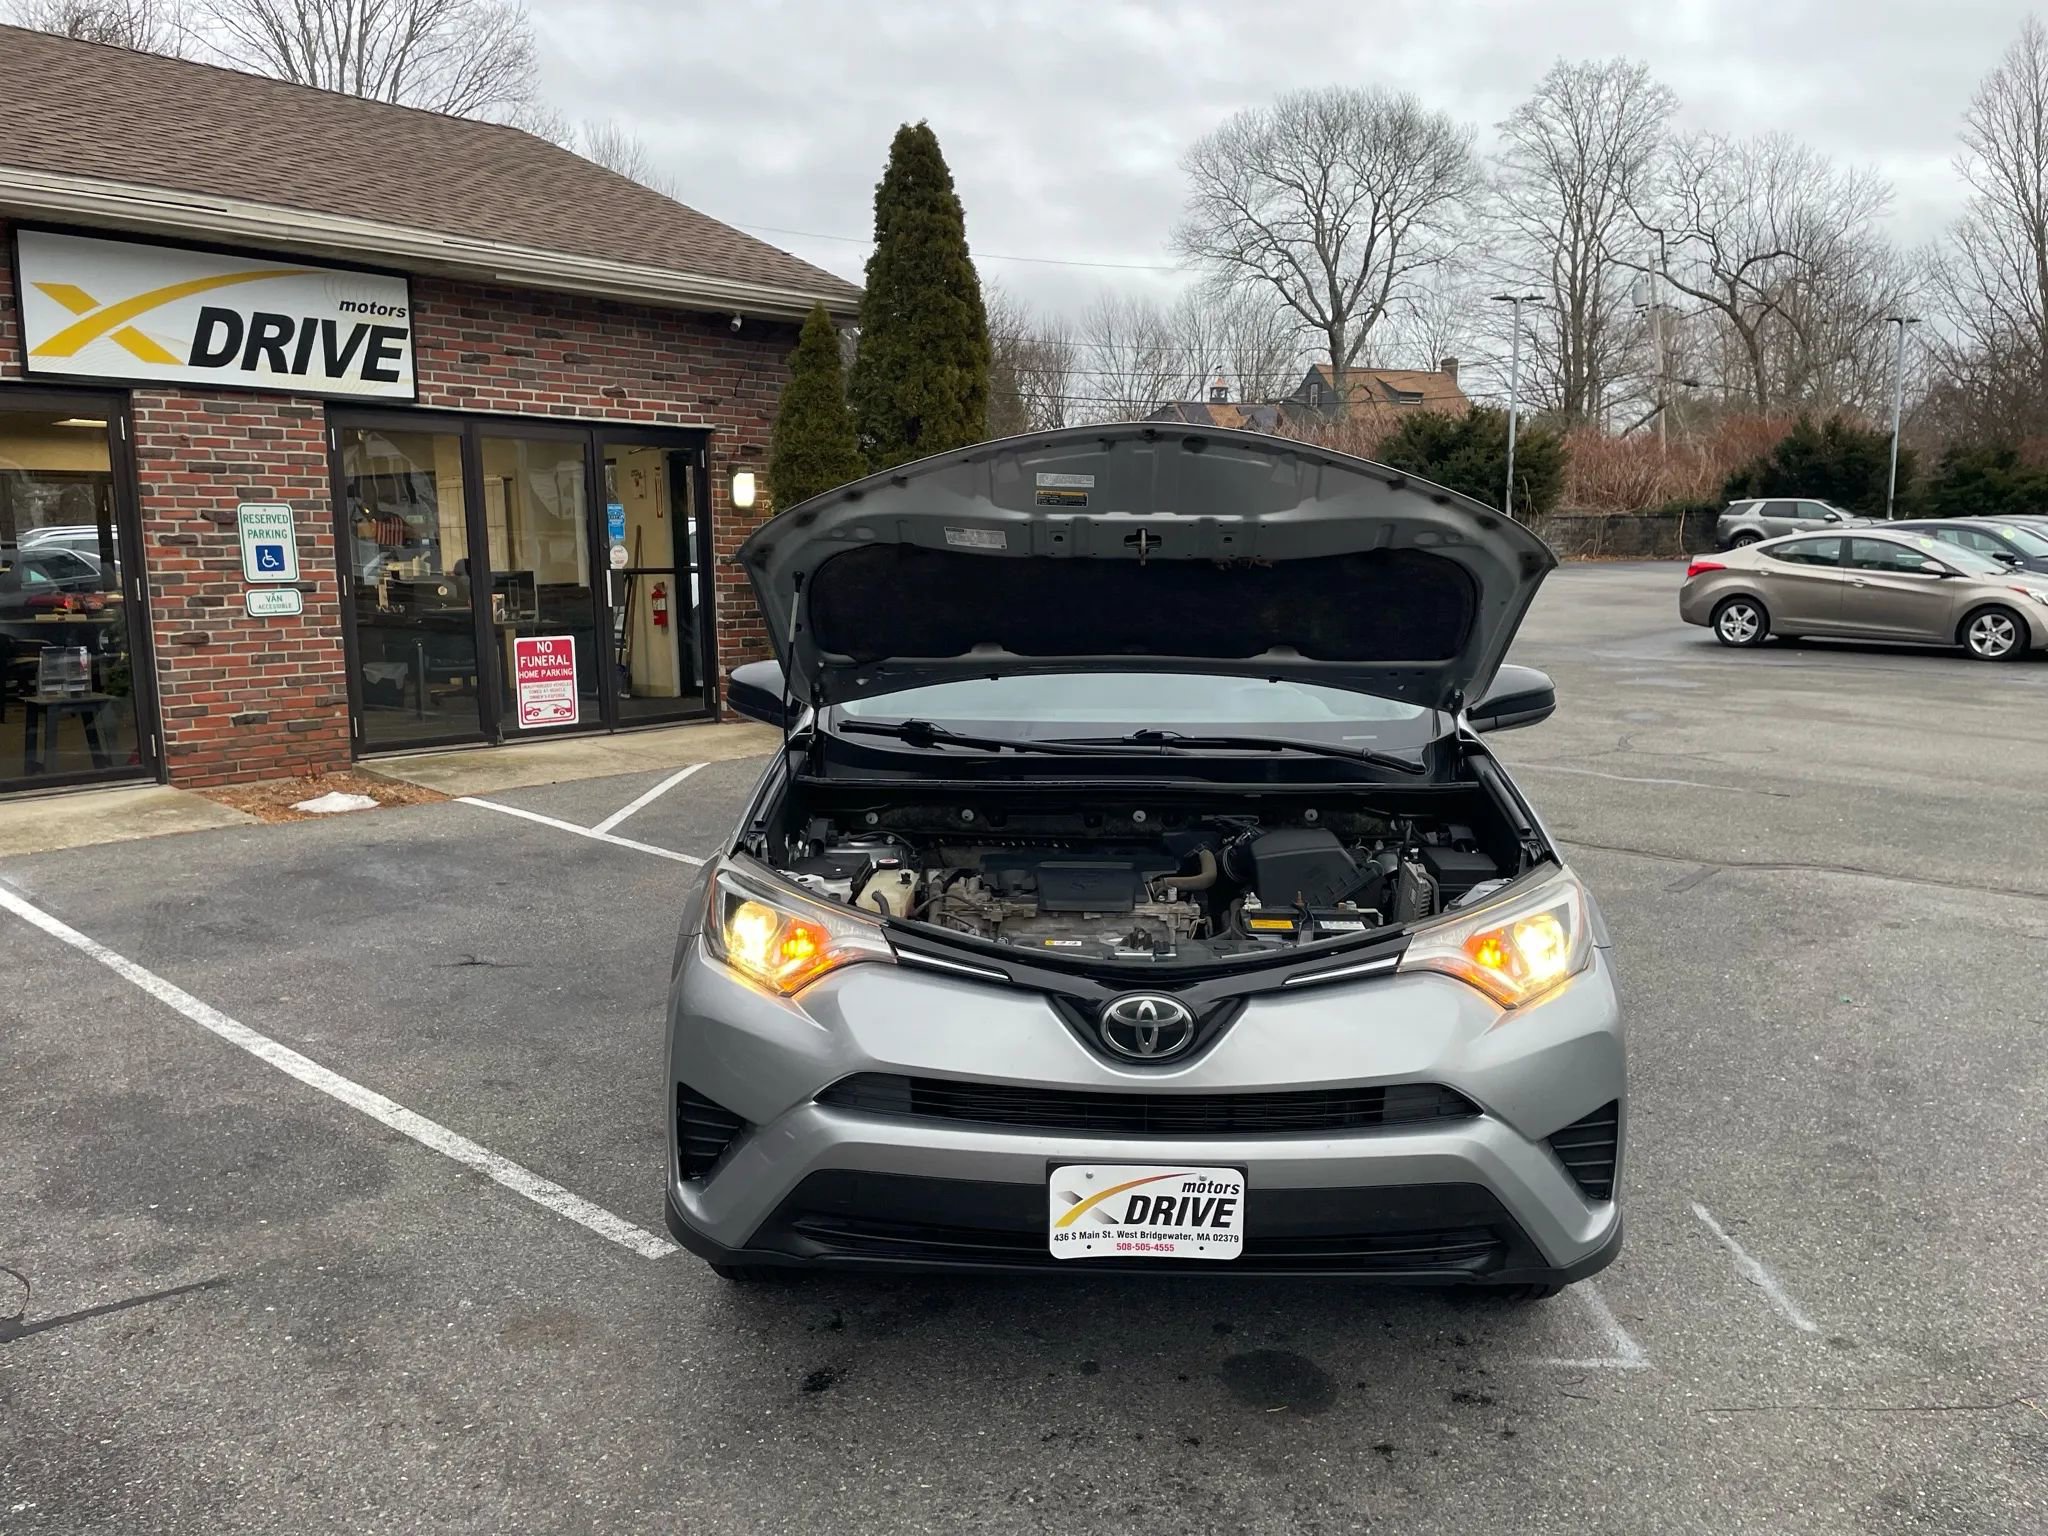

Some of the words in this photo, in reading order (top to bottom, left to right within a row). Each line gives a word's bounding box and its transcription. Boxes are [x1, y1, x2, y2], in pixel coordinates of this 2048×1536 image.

[338, 299, 408, 319] motors
[188, 306, 409, 382] DRIVE
[243, 514, 289, 524] RESERVED
[247, 529, 288, 539] PARKING
[536, 641, 553, 653] NO
[520, 654, 571, 668] FUNERAL
[518, 669, 539, 679] HOME
[541, 668, 573, 677] PARKING
[1181, 1180, 1240, 1195] motors
[1123, 1195, 1237, 1228] DRIVE
[1054, 1233, 1069, 1242] 436
[1071, 1232, 1077, 1240] S
[1079, 1231, 1100, 1239] Main
[1102, 1230, 1114, 1239] St.
[1116, 1230, 1138, 1239] West
[1140, 1231, 1194, 1241] Bridgewater,
[1196, 1233, 1211, 1241] MA
[1213, 1233, 1239, 1242] 02379
[1116, 1242, 1175, 1252] 508-505-4555
